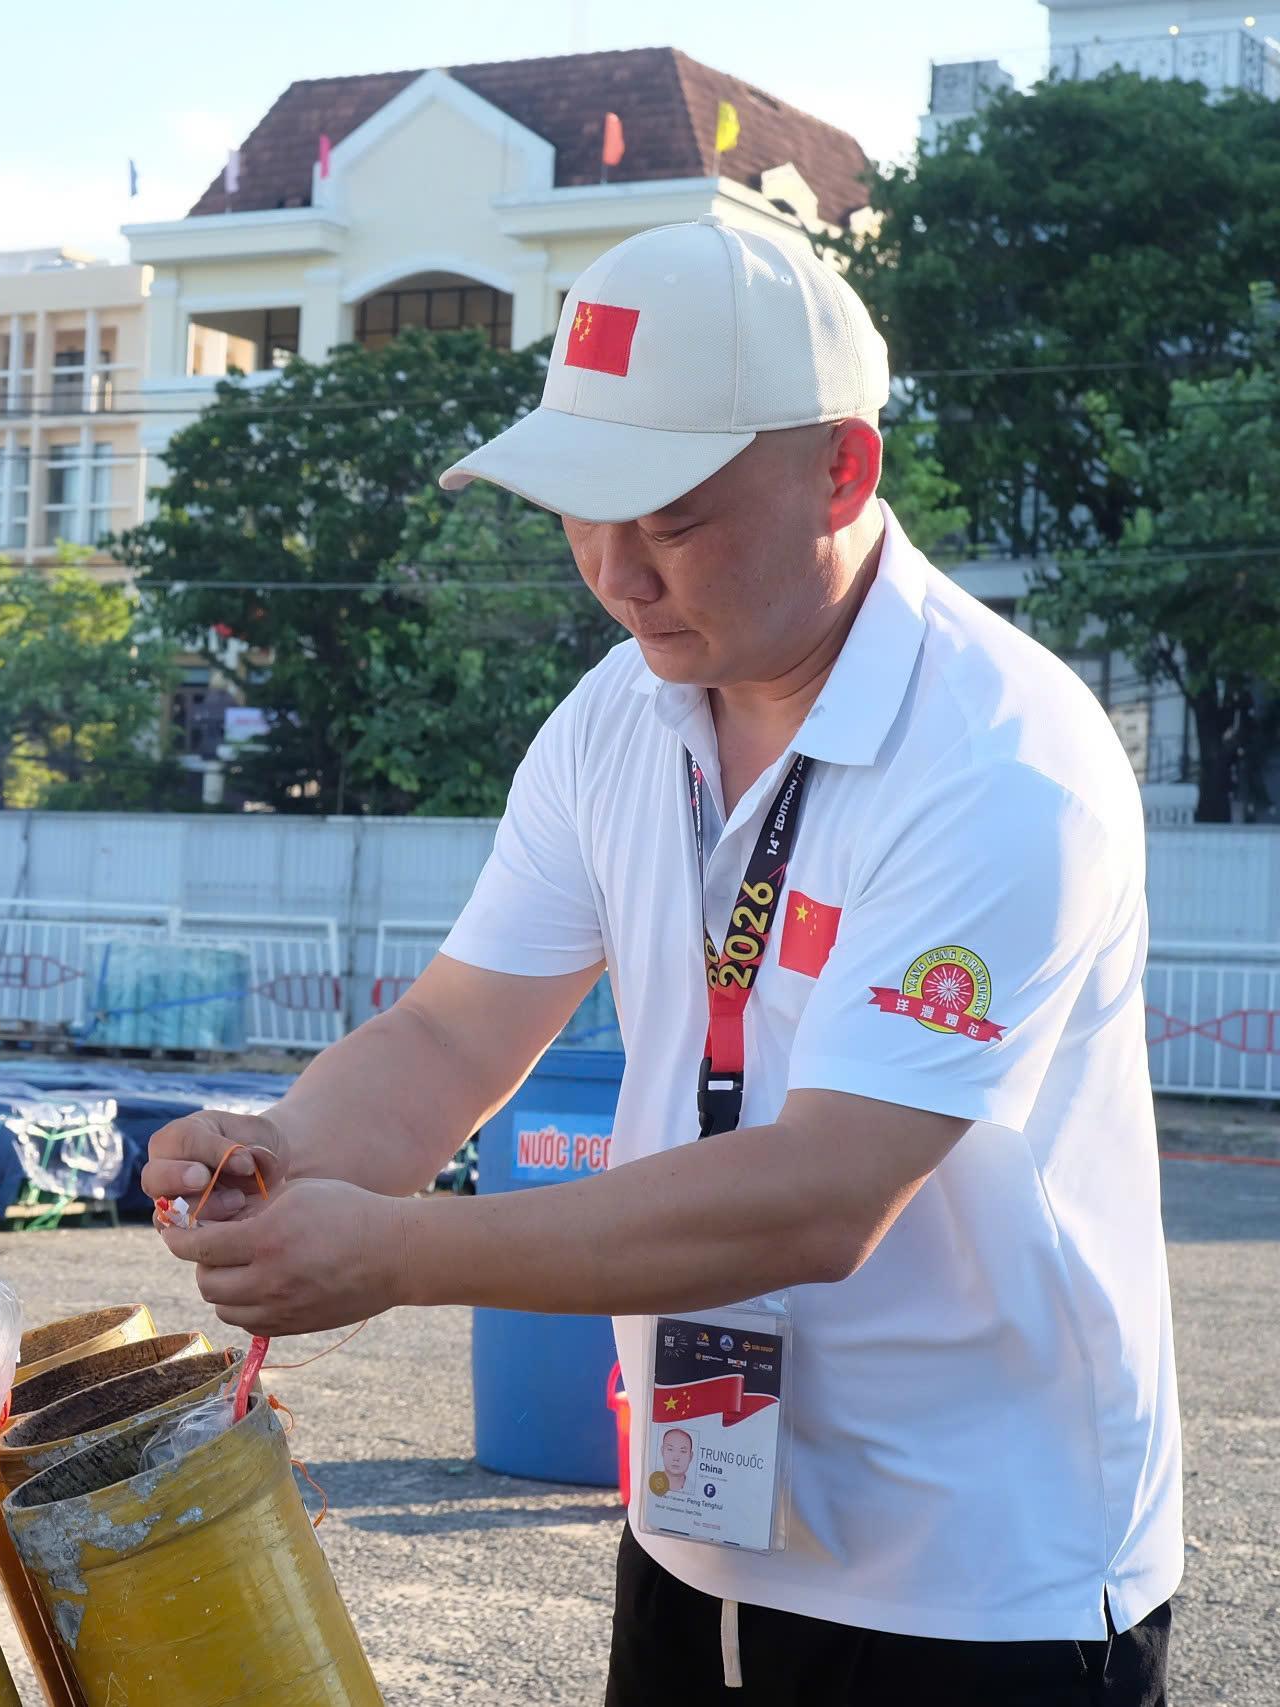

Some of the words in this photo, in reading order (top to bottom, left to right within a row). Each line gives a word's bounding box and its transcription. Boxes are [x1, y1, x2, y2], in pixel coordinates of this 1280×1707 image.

[774, 779, 799, 831] EDITION
[718, 880, 774, 989] 2026
[906, 962, 927, 994] YANG
[926, 949, 957, 965] FENG
[960, 952, 989, 1017] FIREWORKS
[518, 1125, 569, 1169] NƯỚC
[699, 1462, 723, 1475] China
[700, 1446, 735, 1465] TRUNG
[736, 1453, 764, 1470] QUỐC
